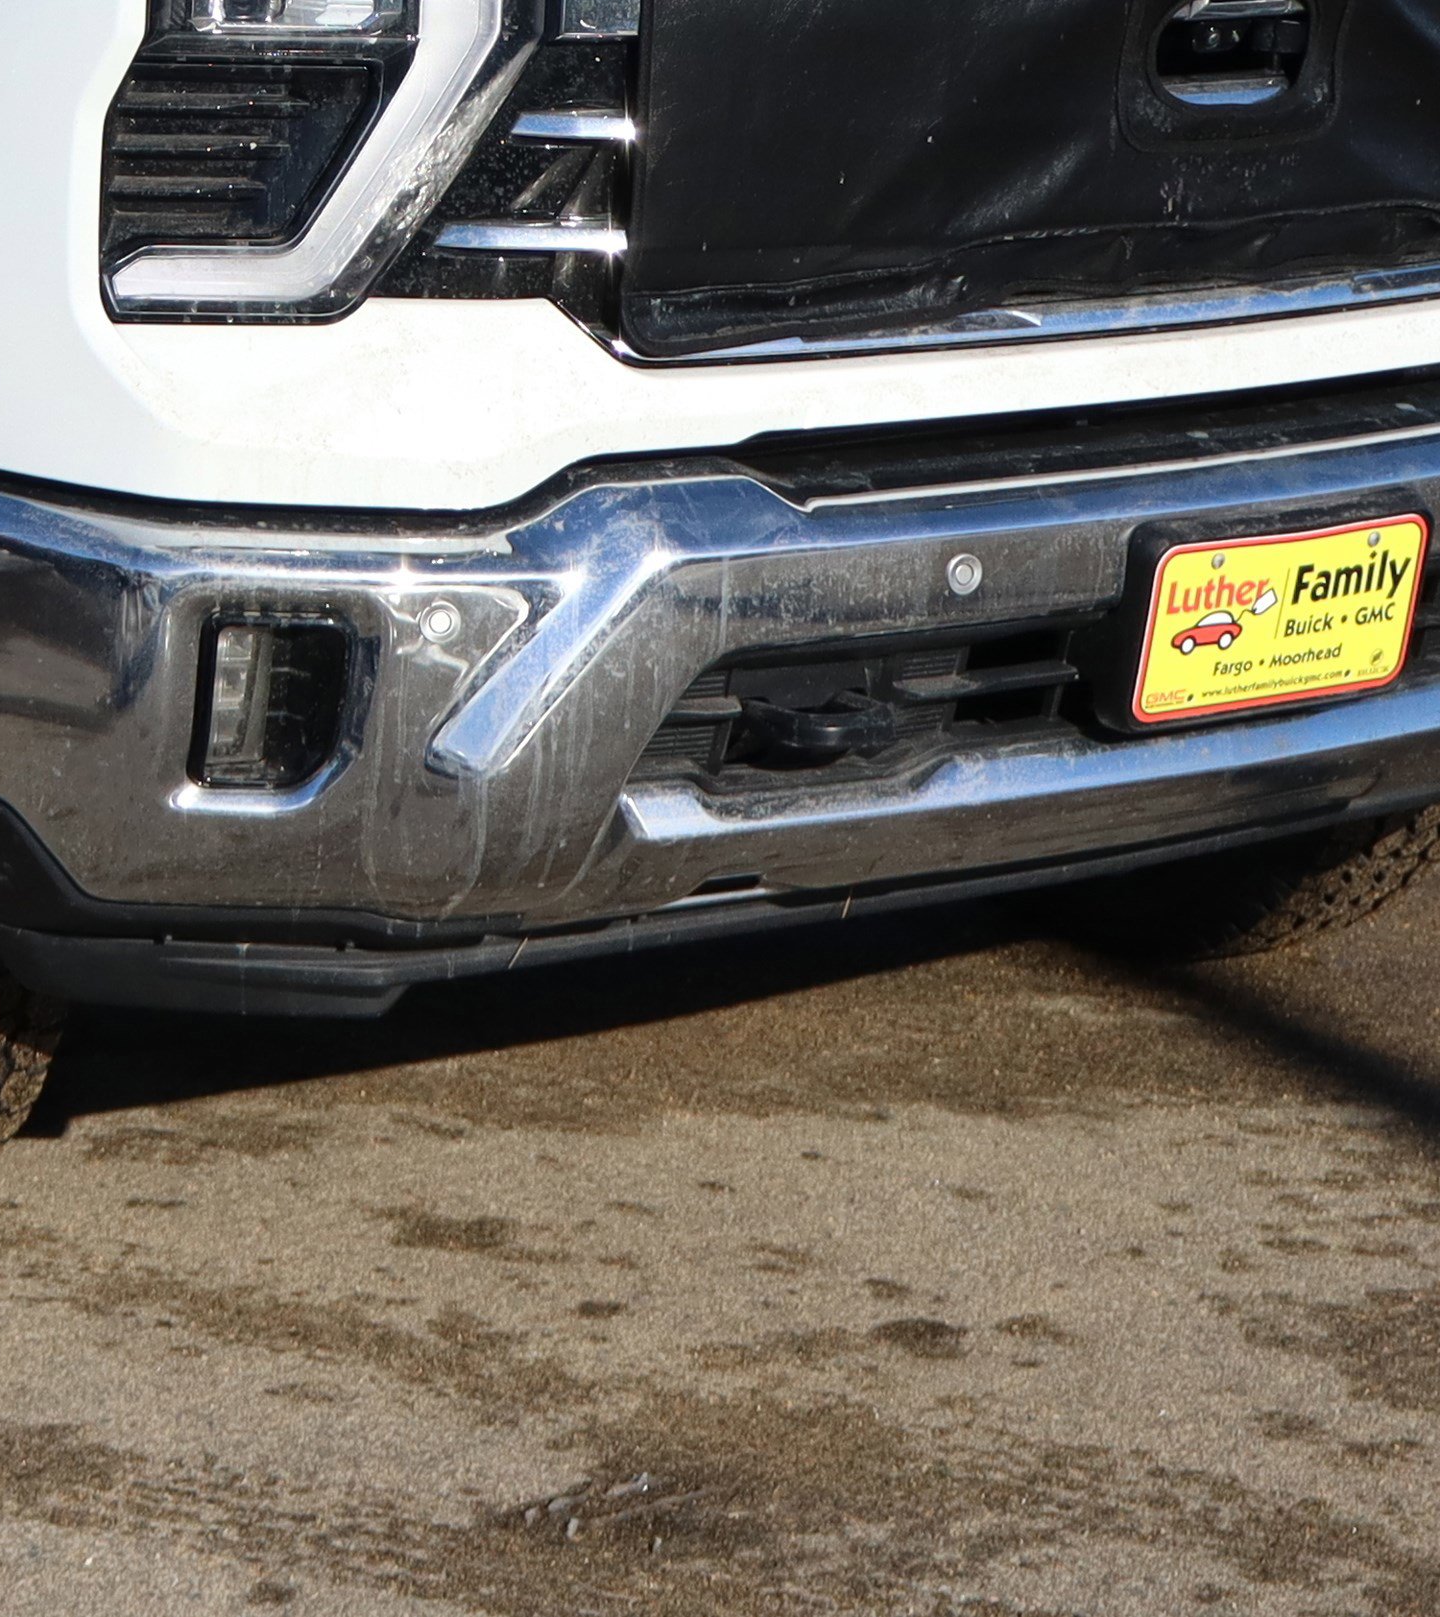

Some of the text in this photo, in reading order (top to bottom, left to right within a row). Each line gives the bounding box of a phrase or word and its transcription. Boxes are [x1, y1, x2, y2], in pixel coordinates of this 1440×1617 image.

[1166, 574, 1271, 615] Luther
[1292, 550, 1411, 605] Family
[1283, 602, 1396, 638] Buick GMC
[1213, 643, 1343, 677] Fargo Moorhead
[1146, 689, 1186, 704] GMC
